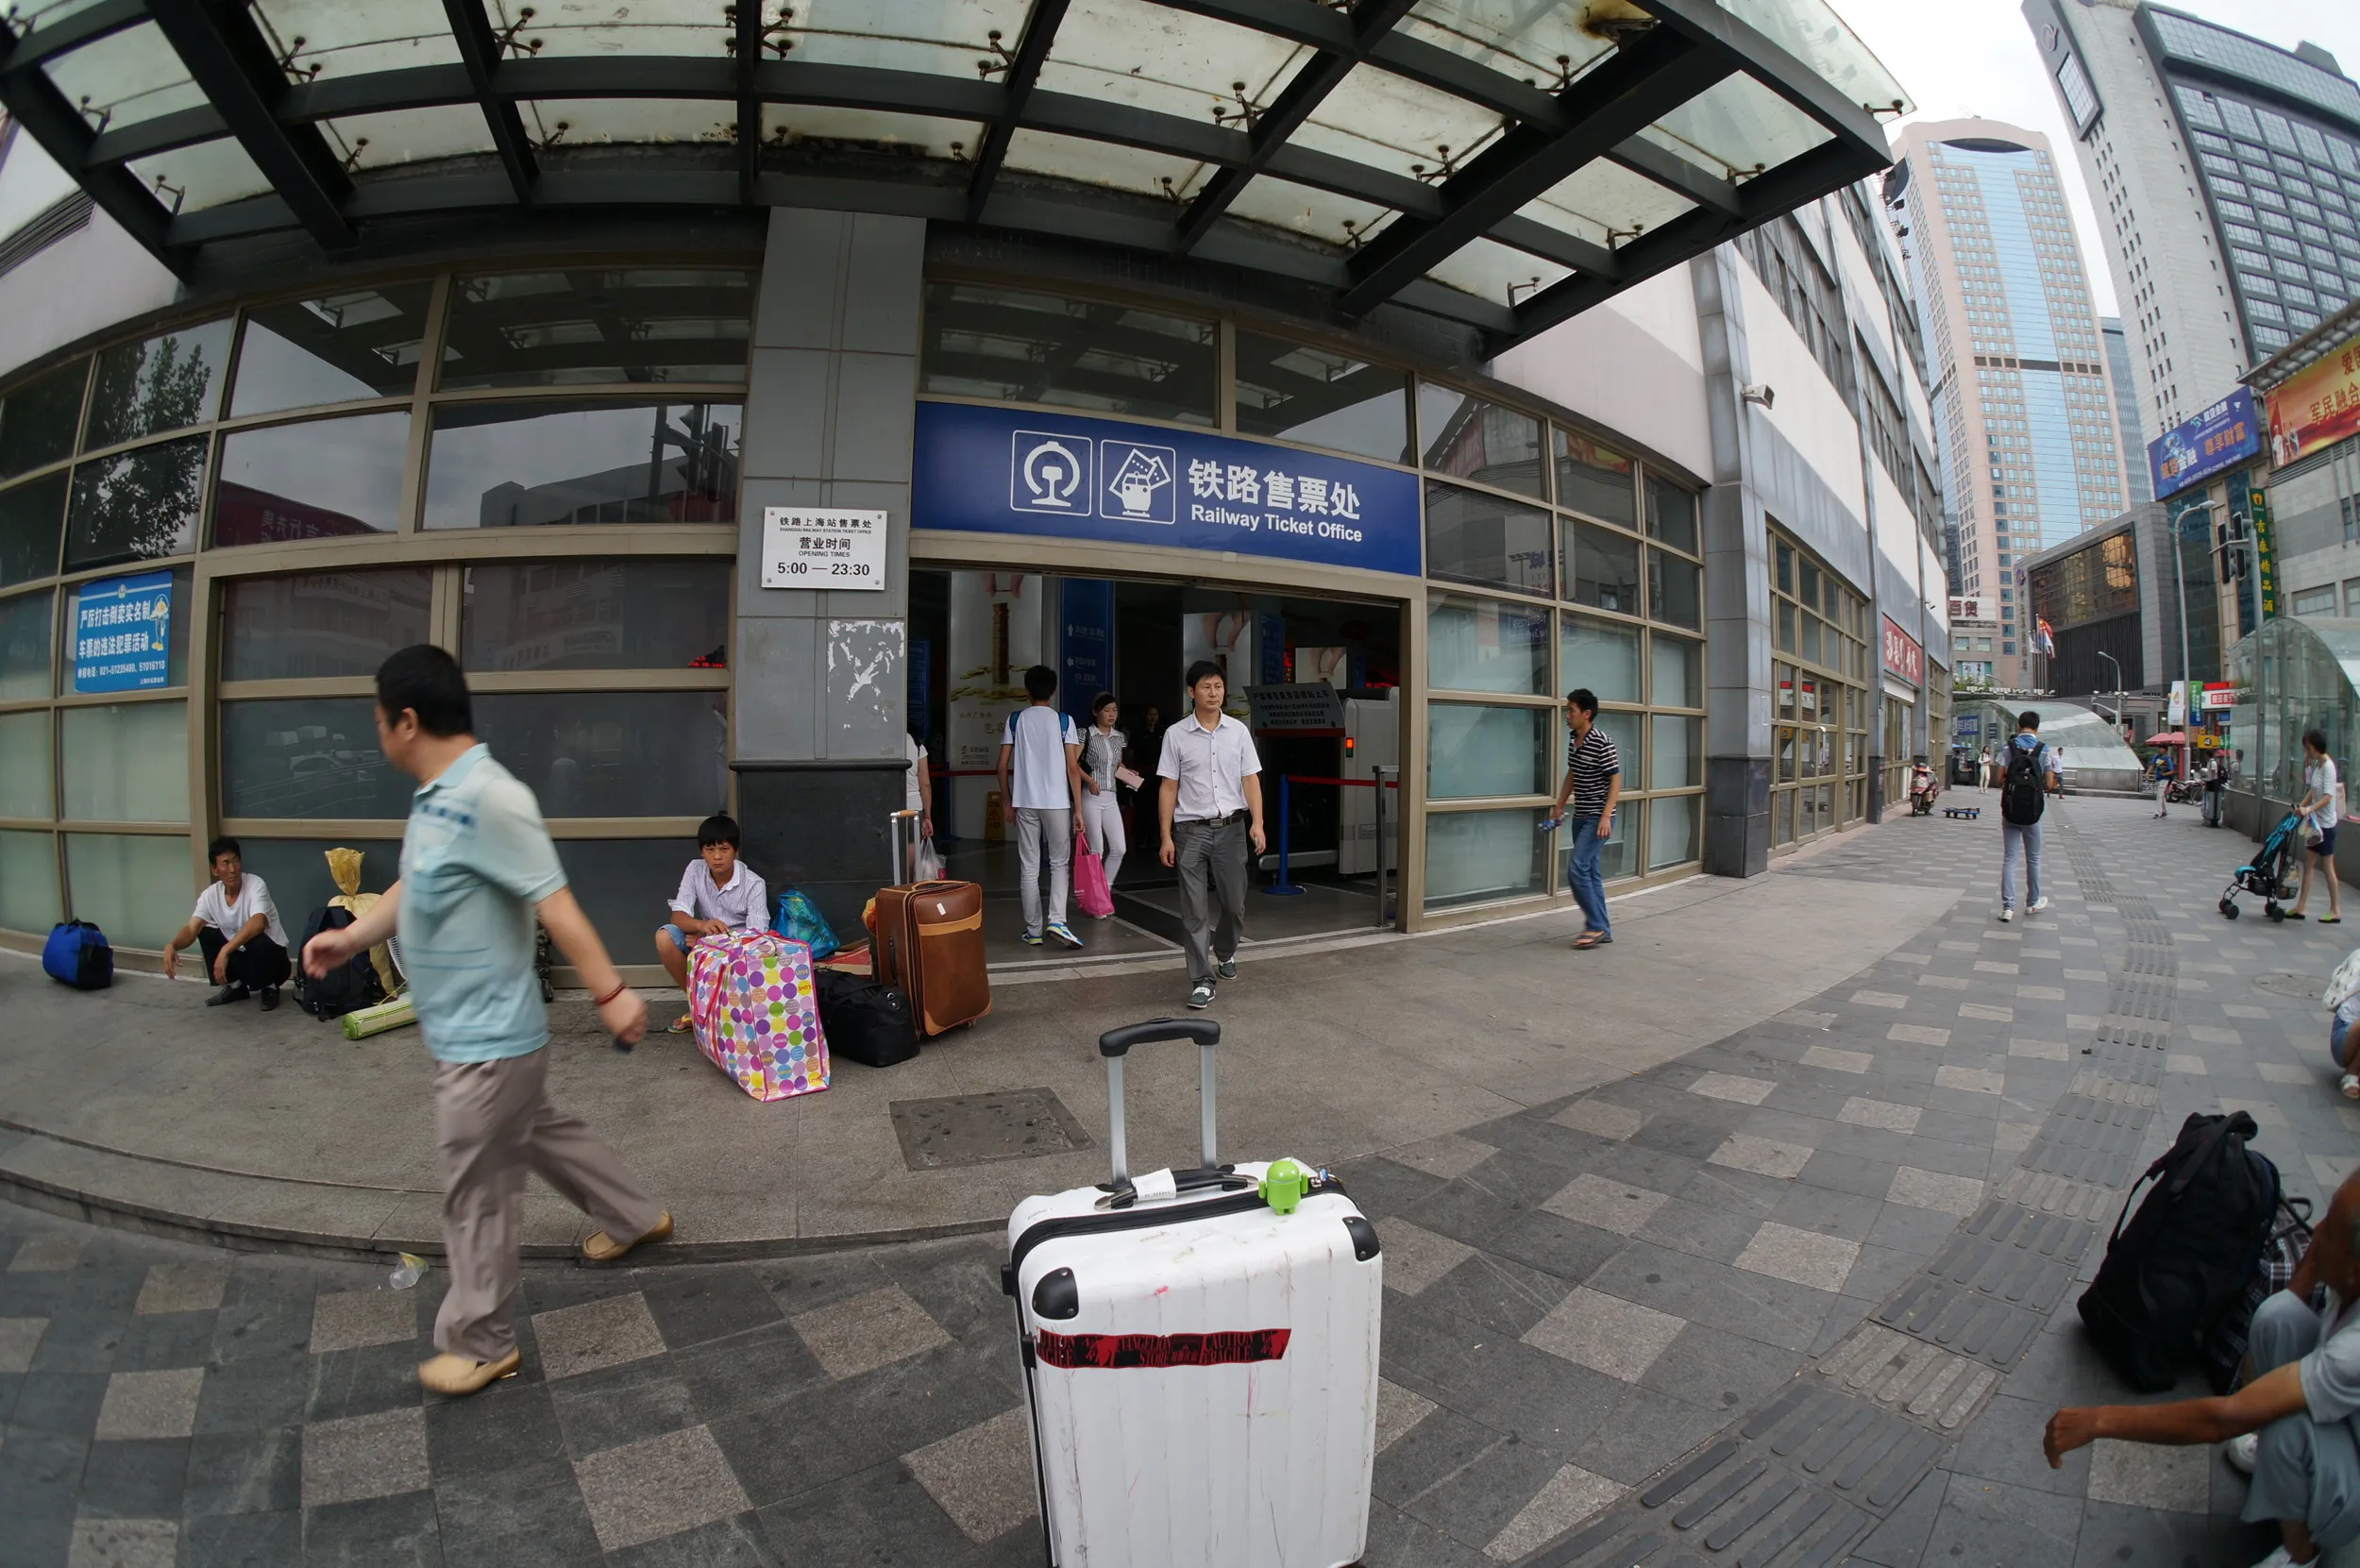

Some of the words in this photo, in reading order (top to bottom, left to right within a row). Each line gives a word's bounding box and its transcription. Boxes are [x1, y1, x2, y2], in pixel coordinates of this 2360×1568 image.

[1188, 458, 1360, 520] 铁路售票处
[780, 516, 872, 529] 铁路上海站售票处
[1191, 504, 1260, 531] Railway
[1264, 514, 1314, 537] Ticket
[1318, 521, 1362, 543] Office
[800, 537, 851, 550] 营业时间
[778, 562, 807, 575] 5:00
[832, 564, 870, 576] 23:30
[80, 599, 151, 629] 严厉打击倒卖实名制
[78, 631, 149, 659] 车票的违法犯罪活动
[1040, 1331, 1075, 1349] UTION
[1205, 1332, 1254, 1350] CAUTION
[1139, 1351, 1171, 1366] STORE
[1204, 1345, 1251, 1364] FRAGILE
